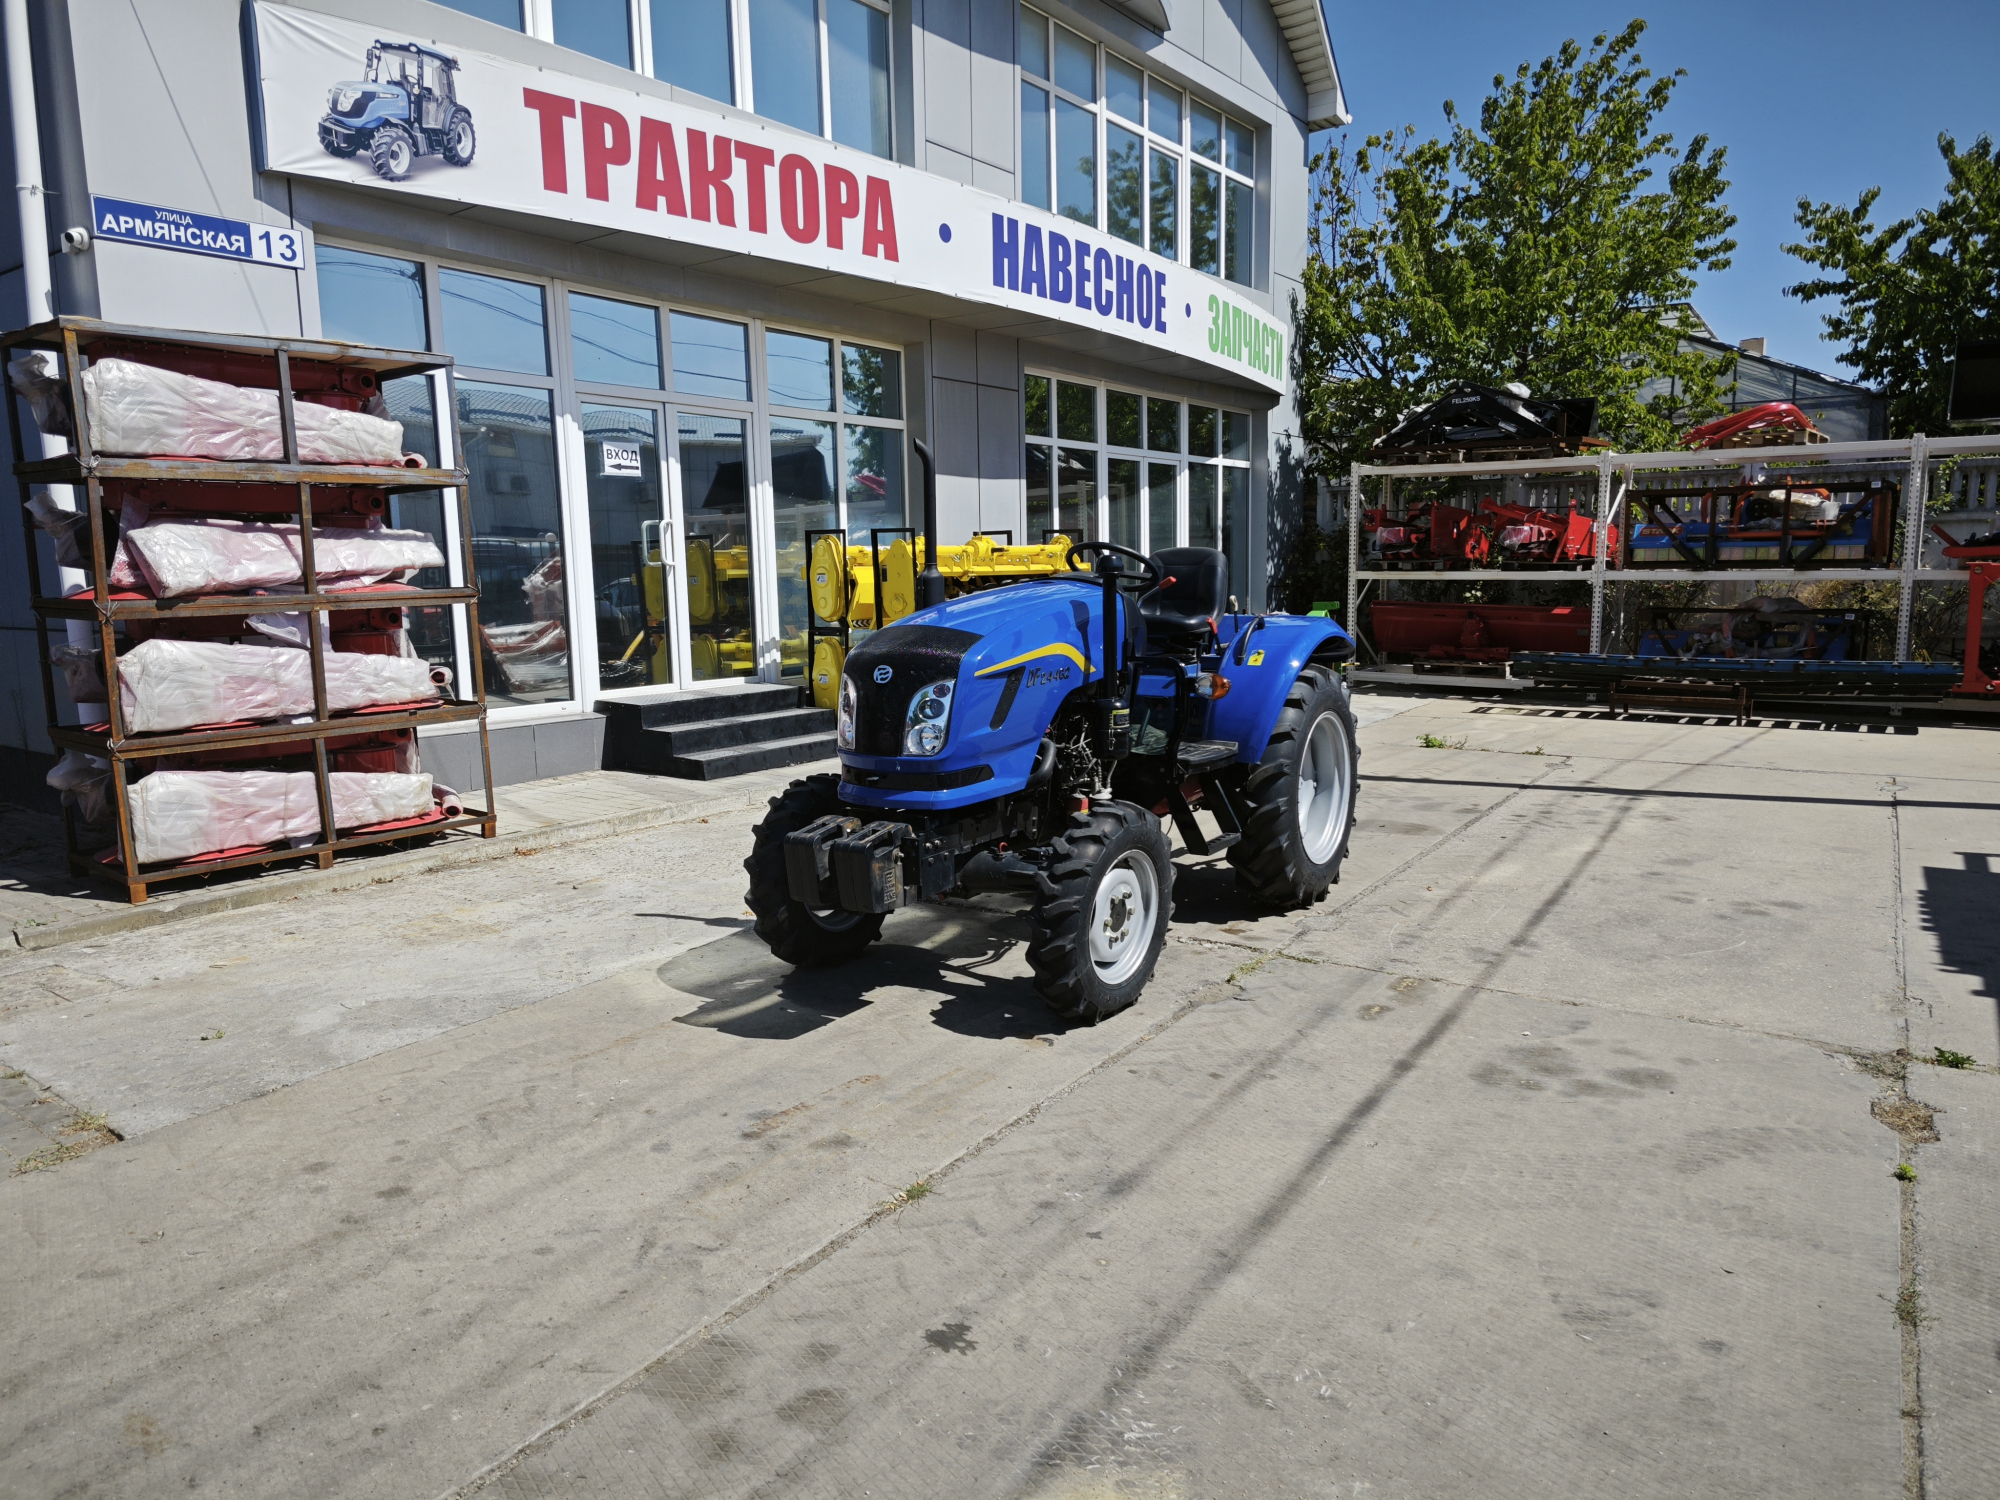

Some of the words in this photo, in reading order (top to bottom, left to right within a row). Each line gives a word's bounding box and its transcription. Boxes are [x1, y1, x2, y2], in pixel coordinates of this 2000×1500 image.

[154, 209, 193, 226] УЛИЦА
[101, 213, 246, 253] АРМЯНСКАЯ
[258, 230, 298, 262] 13
[522, 86, 900, 263] ТРАКТОРА
[991, 212, 1167, 334] НАВЕСНОЕ
[1208, 294, 1284, 382] ЗАПЧАСТИ
[1451, 395, 1481, 404] FEL250KS
[606, 448, 639, 464] ВХОД
